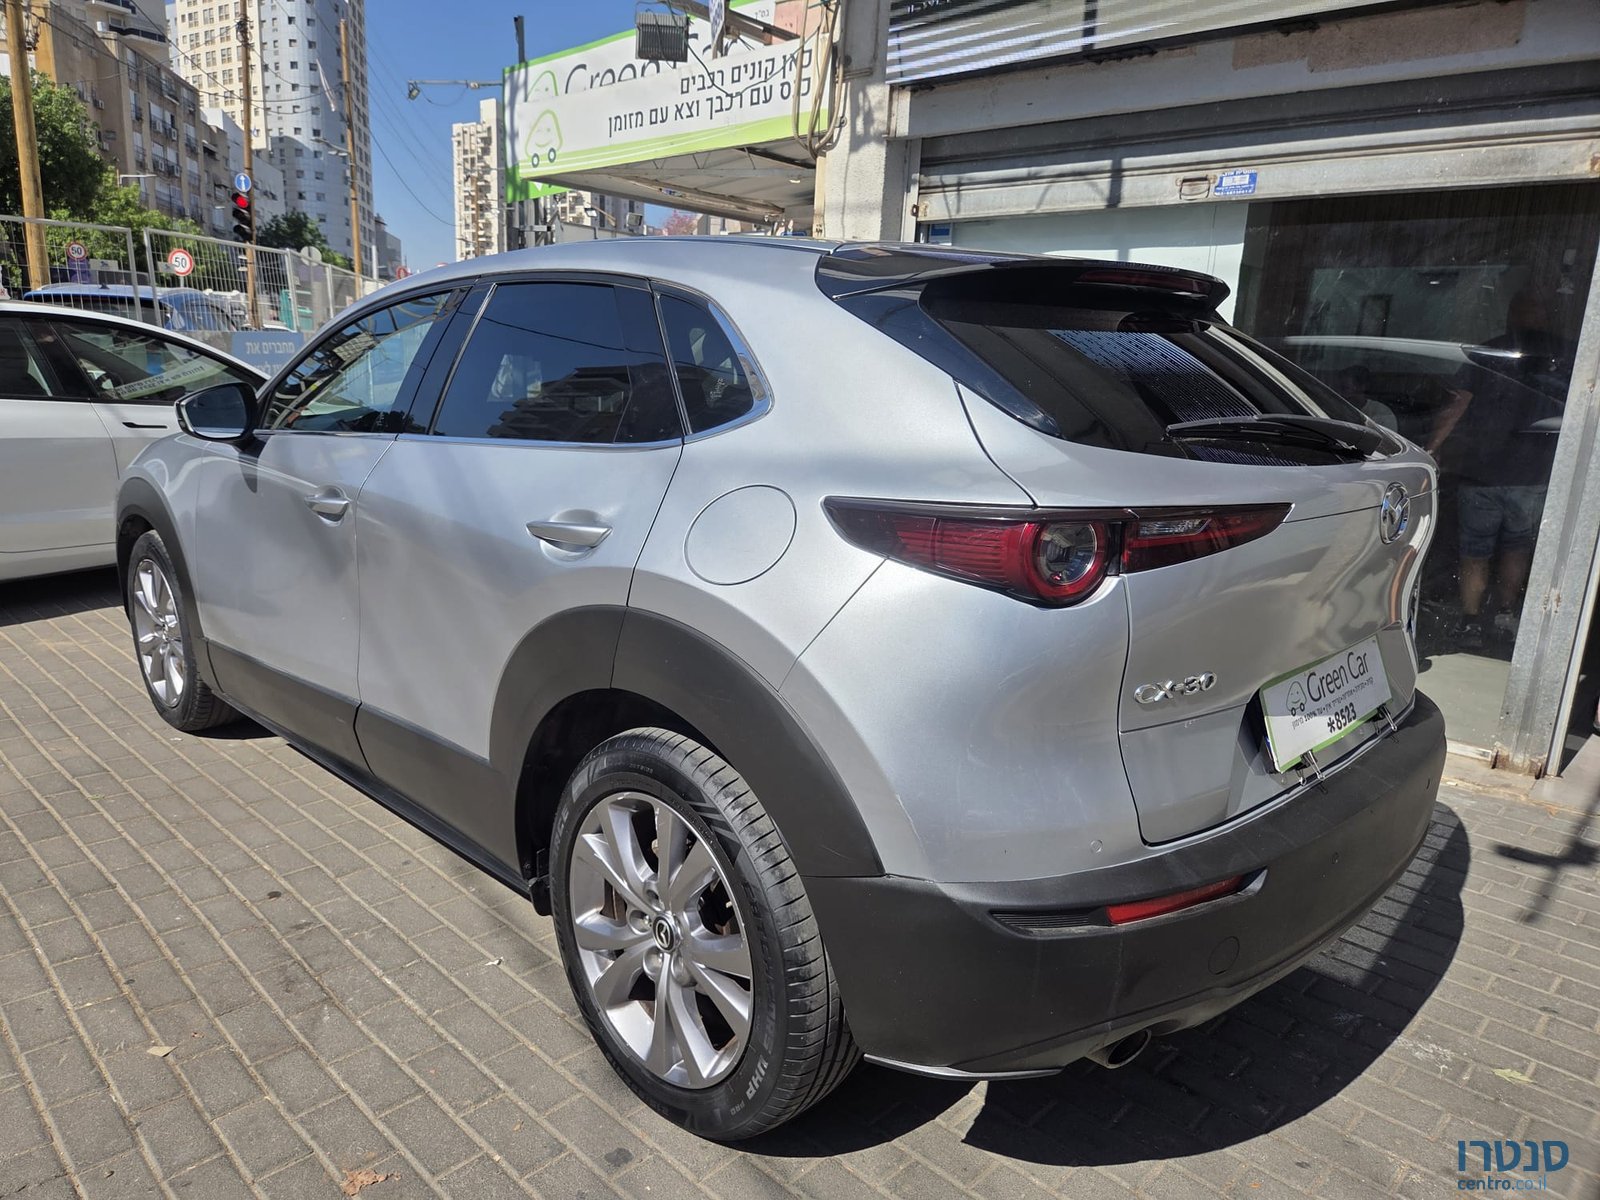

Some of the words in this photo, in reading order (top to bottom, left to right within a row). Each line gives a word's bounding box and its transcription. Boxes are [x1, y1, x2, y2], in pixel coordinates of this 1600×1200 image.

[680, 69, 725, 95] רכבים
[731, 58, 776, 84] קונים
[749, 84, 773, 107] עם
[780, 77, 812, 100] כס
[650, 105, 669, 125] עם
[674, 99, 700, 121] וצא
[705, 91, 743, 120] רכבך
[608, 110, 644, 138] מזומן
[71, 246, 83, 256] 50
[174, 256, 187, 269] 50
[245, 341, 261, 355] את
[261, 341, 296, 354] מחברים
[1133, 670, 1218, 704] CX-30
[1306, 667, 1350, 702] Green
[1346, 652, 1369, 680] Car
[745, 1054, 769, 1100] UHP
